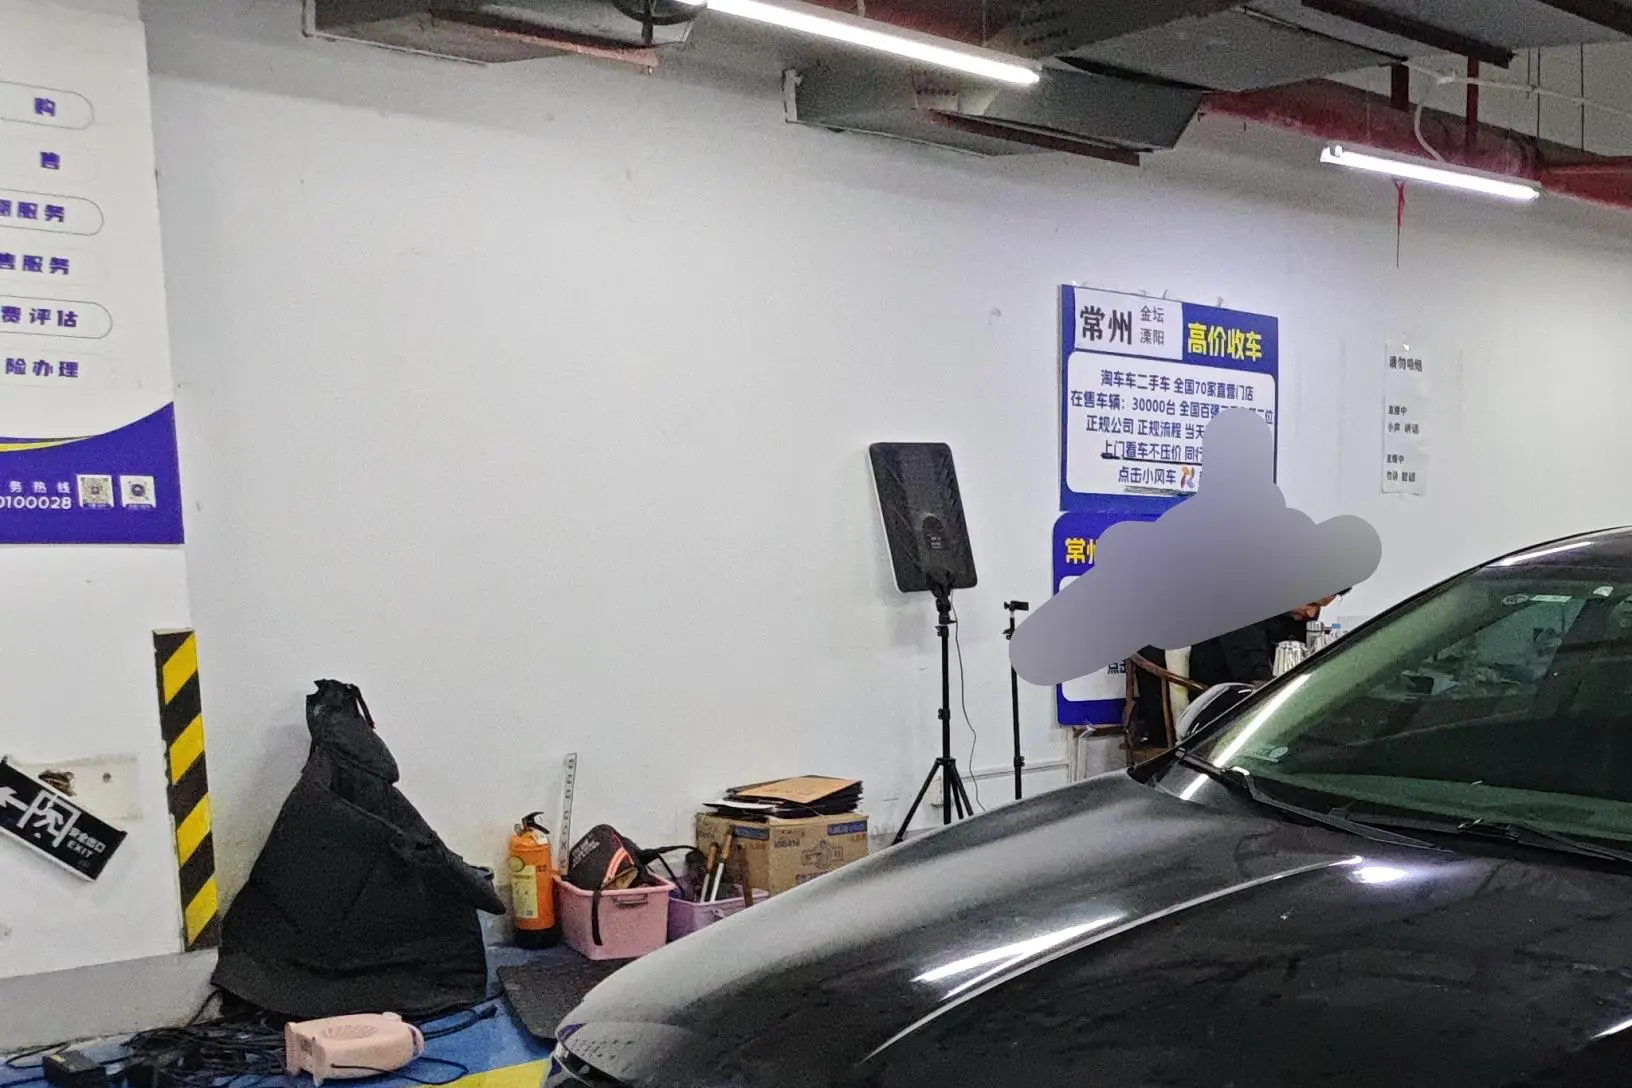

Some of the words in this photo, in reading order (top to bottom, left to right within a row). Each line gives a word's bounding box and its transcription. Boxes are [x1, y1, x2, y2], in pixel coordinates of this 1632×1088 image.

[1080, 305, 1132, 345] 常州
[1140, 304, 1165, 324] 金坛
[1140, 328, 1165, 346] 溧阳
[1187, 322, 1263, 362] 高价收车
[1101, 369, 1171, 392] 淘车车二手车
[1173, 377, 1255, 402] 全国70家直营门店
[1086, 414, 1134, 435] 正规公司
[1137, 419, 1182, 439] 正规流程
[1102, 439, 1181, 461] 上门看车不压价
[1118, 466, 1177, 485] 点击小风车
[66, 840, 94, 858] EXIT
